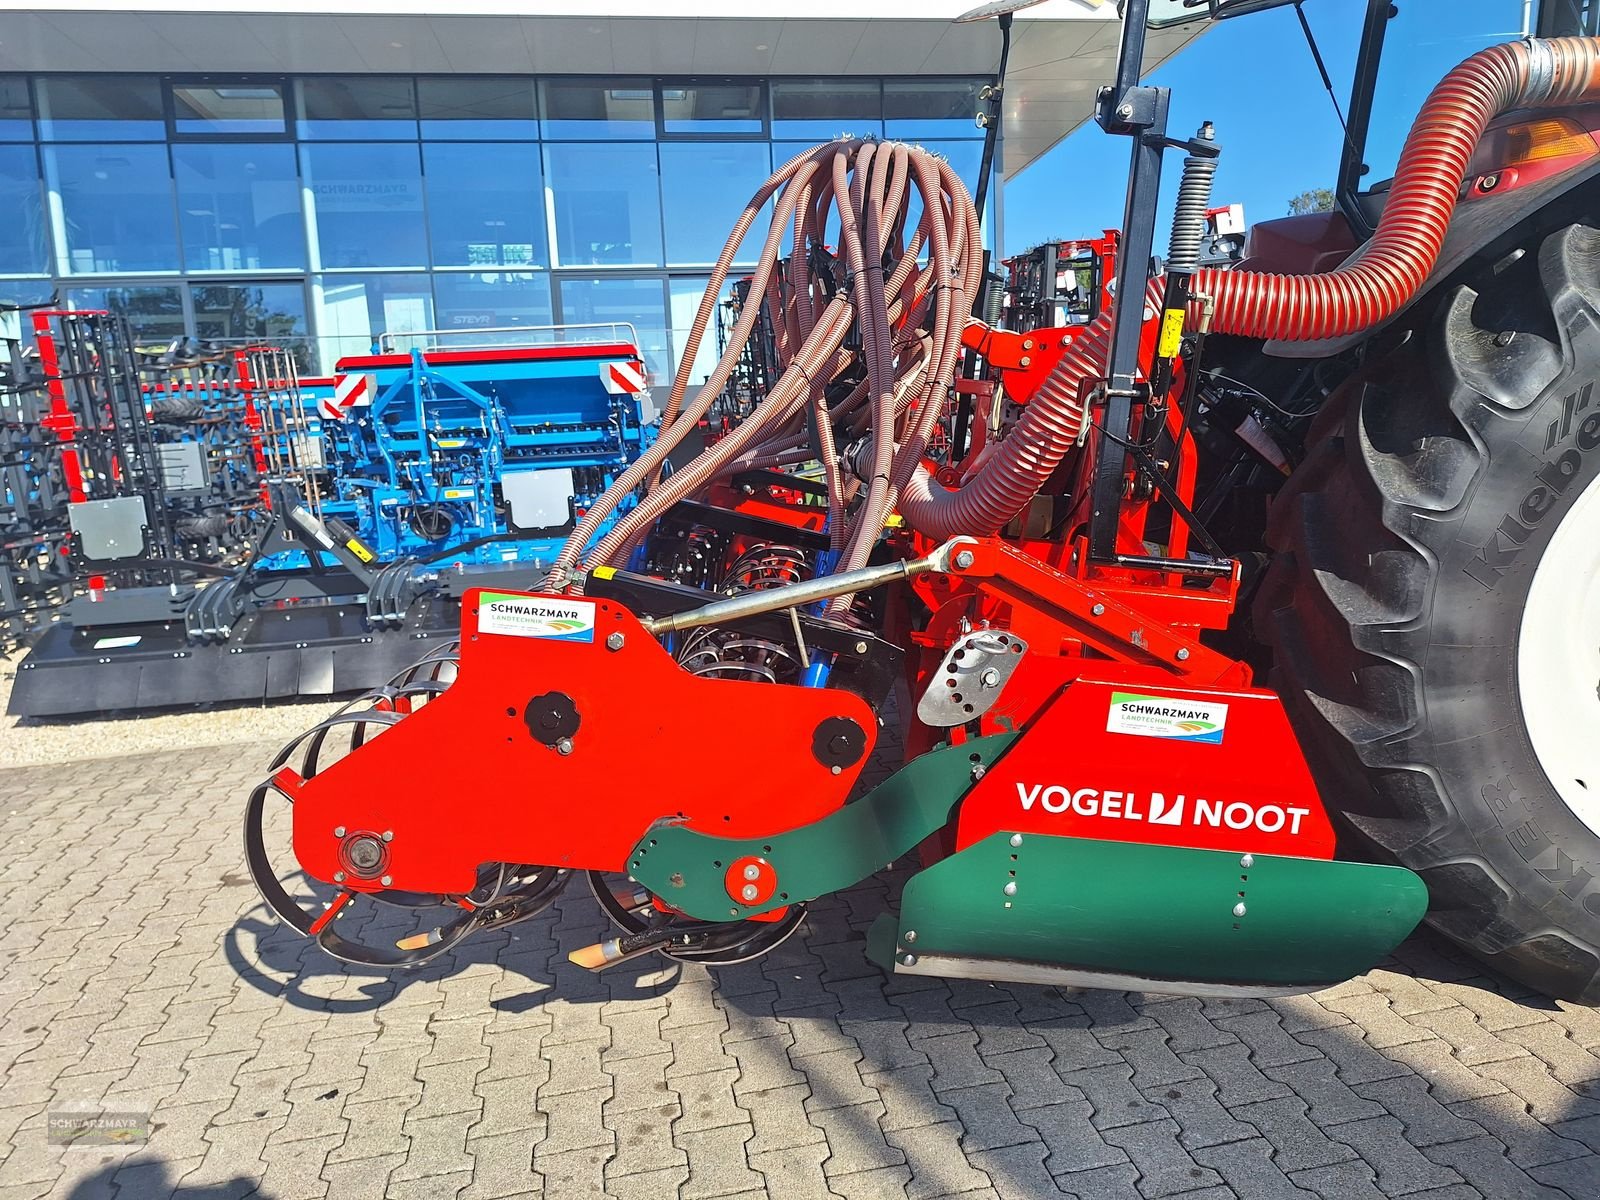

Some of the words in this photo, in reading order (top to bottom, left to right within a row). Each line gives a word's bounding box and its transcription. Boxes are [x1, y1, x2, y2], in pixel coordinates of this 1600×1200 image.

[453, 315, 490, 325] STEYR
[1462, 403, 1600, 592] Klebe
[490, 603, 579, 619] SCHWARZMAYR
[491, 614, 543, 625] LANDTECHNIK
[1121, 703, 1210, 720] SCHWARZMAYR
[1121, 714, 1173, 725] LANDTECHNIK
[1015, 782, 1143, 821] VOGEL
[1193, 799, 1310, 835] NOOT
